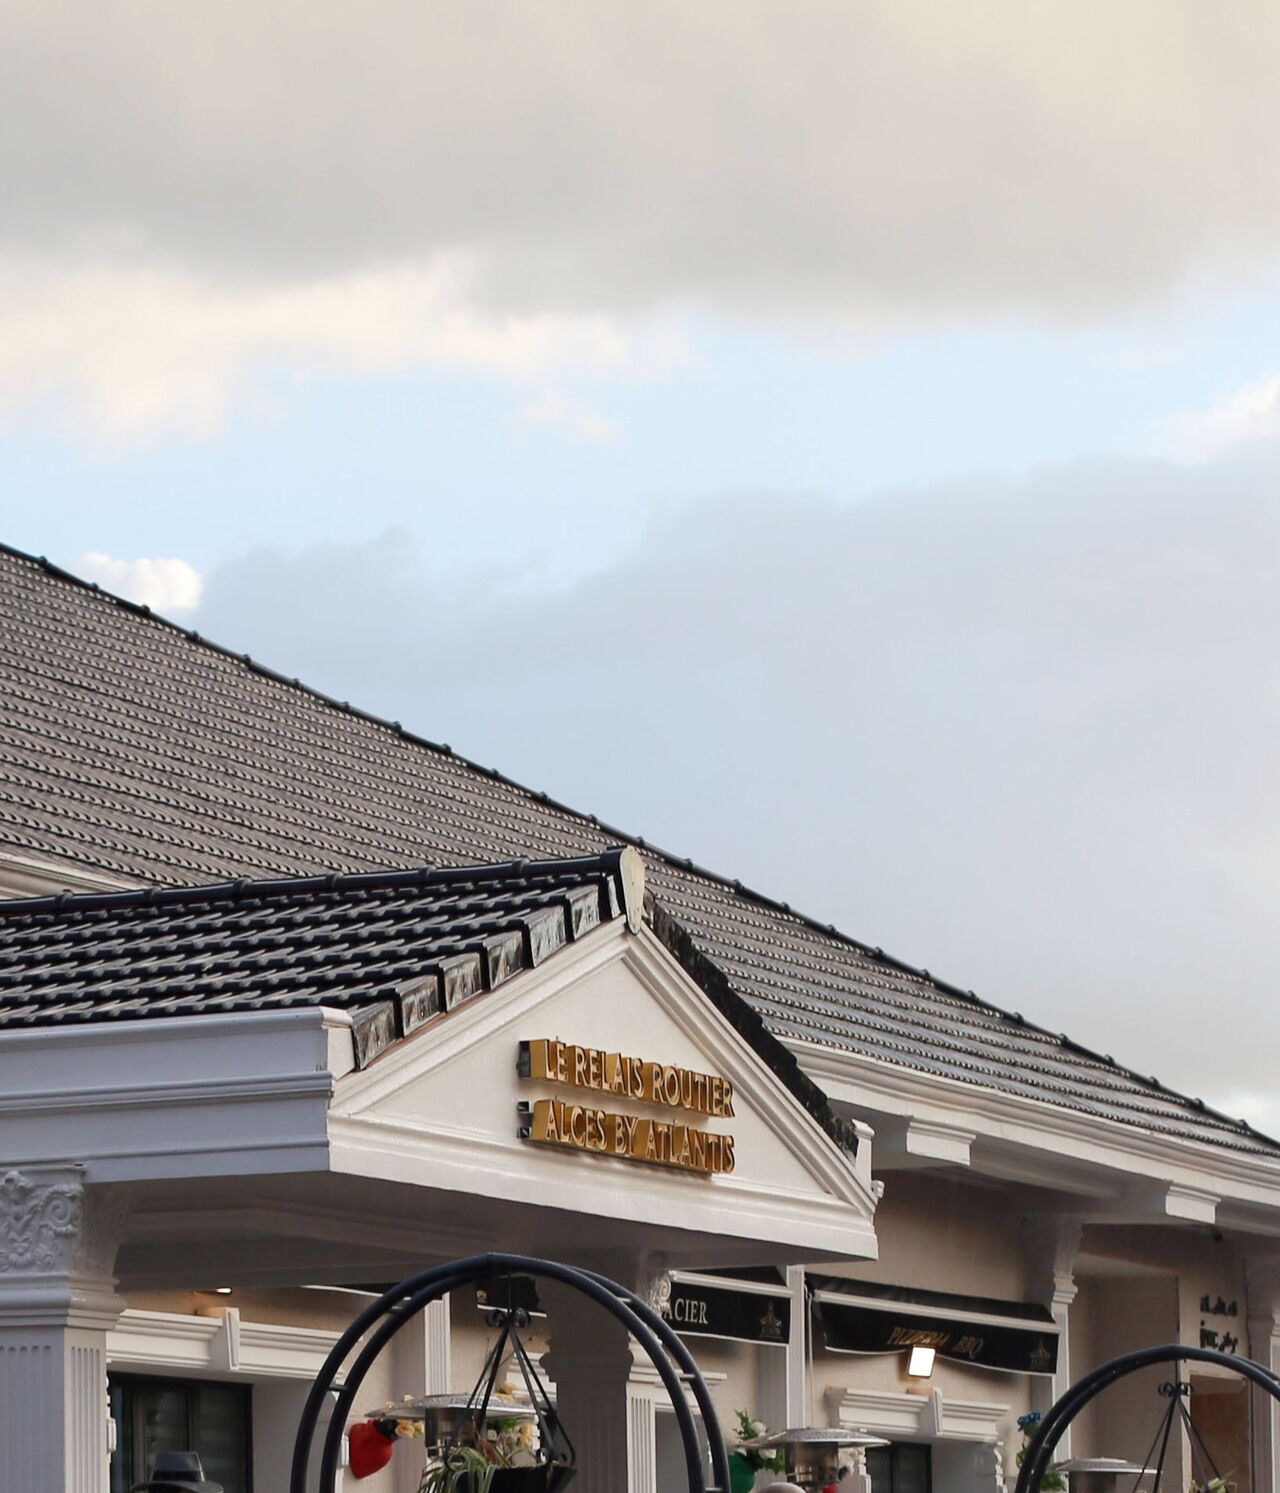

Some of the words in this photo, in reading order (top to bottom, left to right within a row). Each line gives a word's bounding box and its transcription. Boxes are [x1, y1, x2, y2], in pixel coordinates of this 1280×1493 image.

[544, 1039, 568, 1082] LE
[575, 1045, 645, 1098] RELAIS
[652, 1062, 736, 1118] ROUTIER
[545, 1099, 608, 1150] ALCES
[615, 1115, 639, 1155] BY
[645, 1119, 736, 1174] ATLANTIS
[662, 1297, 709, 1325] ACIER
[952, 1335, 985, 1360] BBQ
